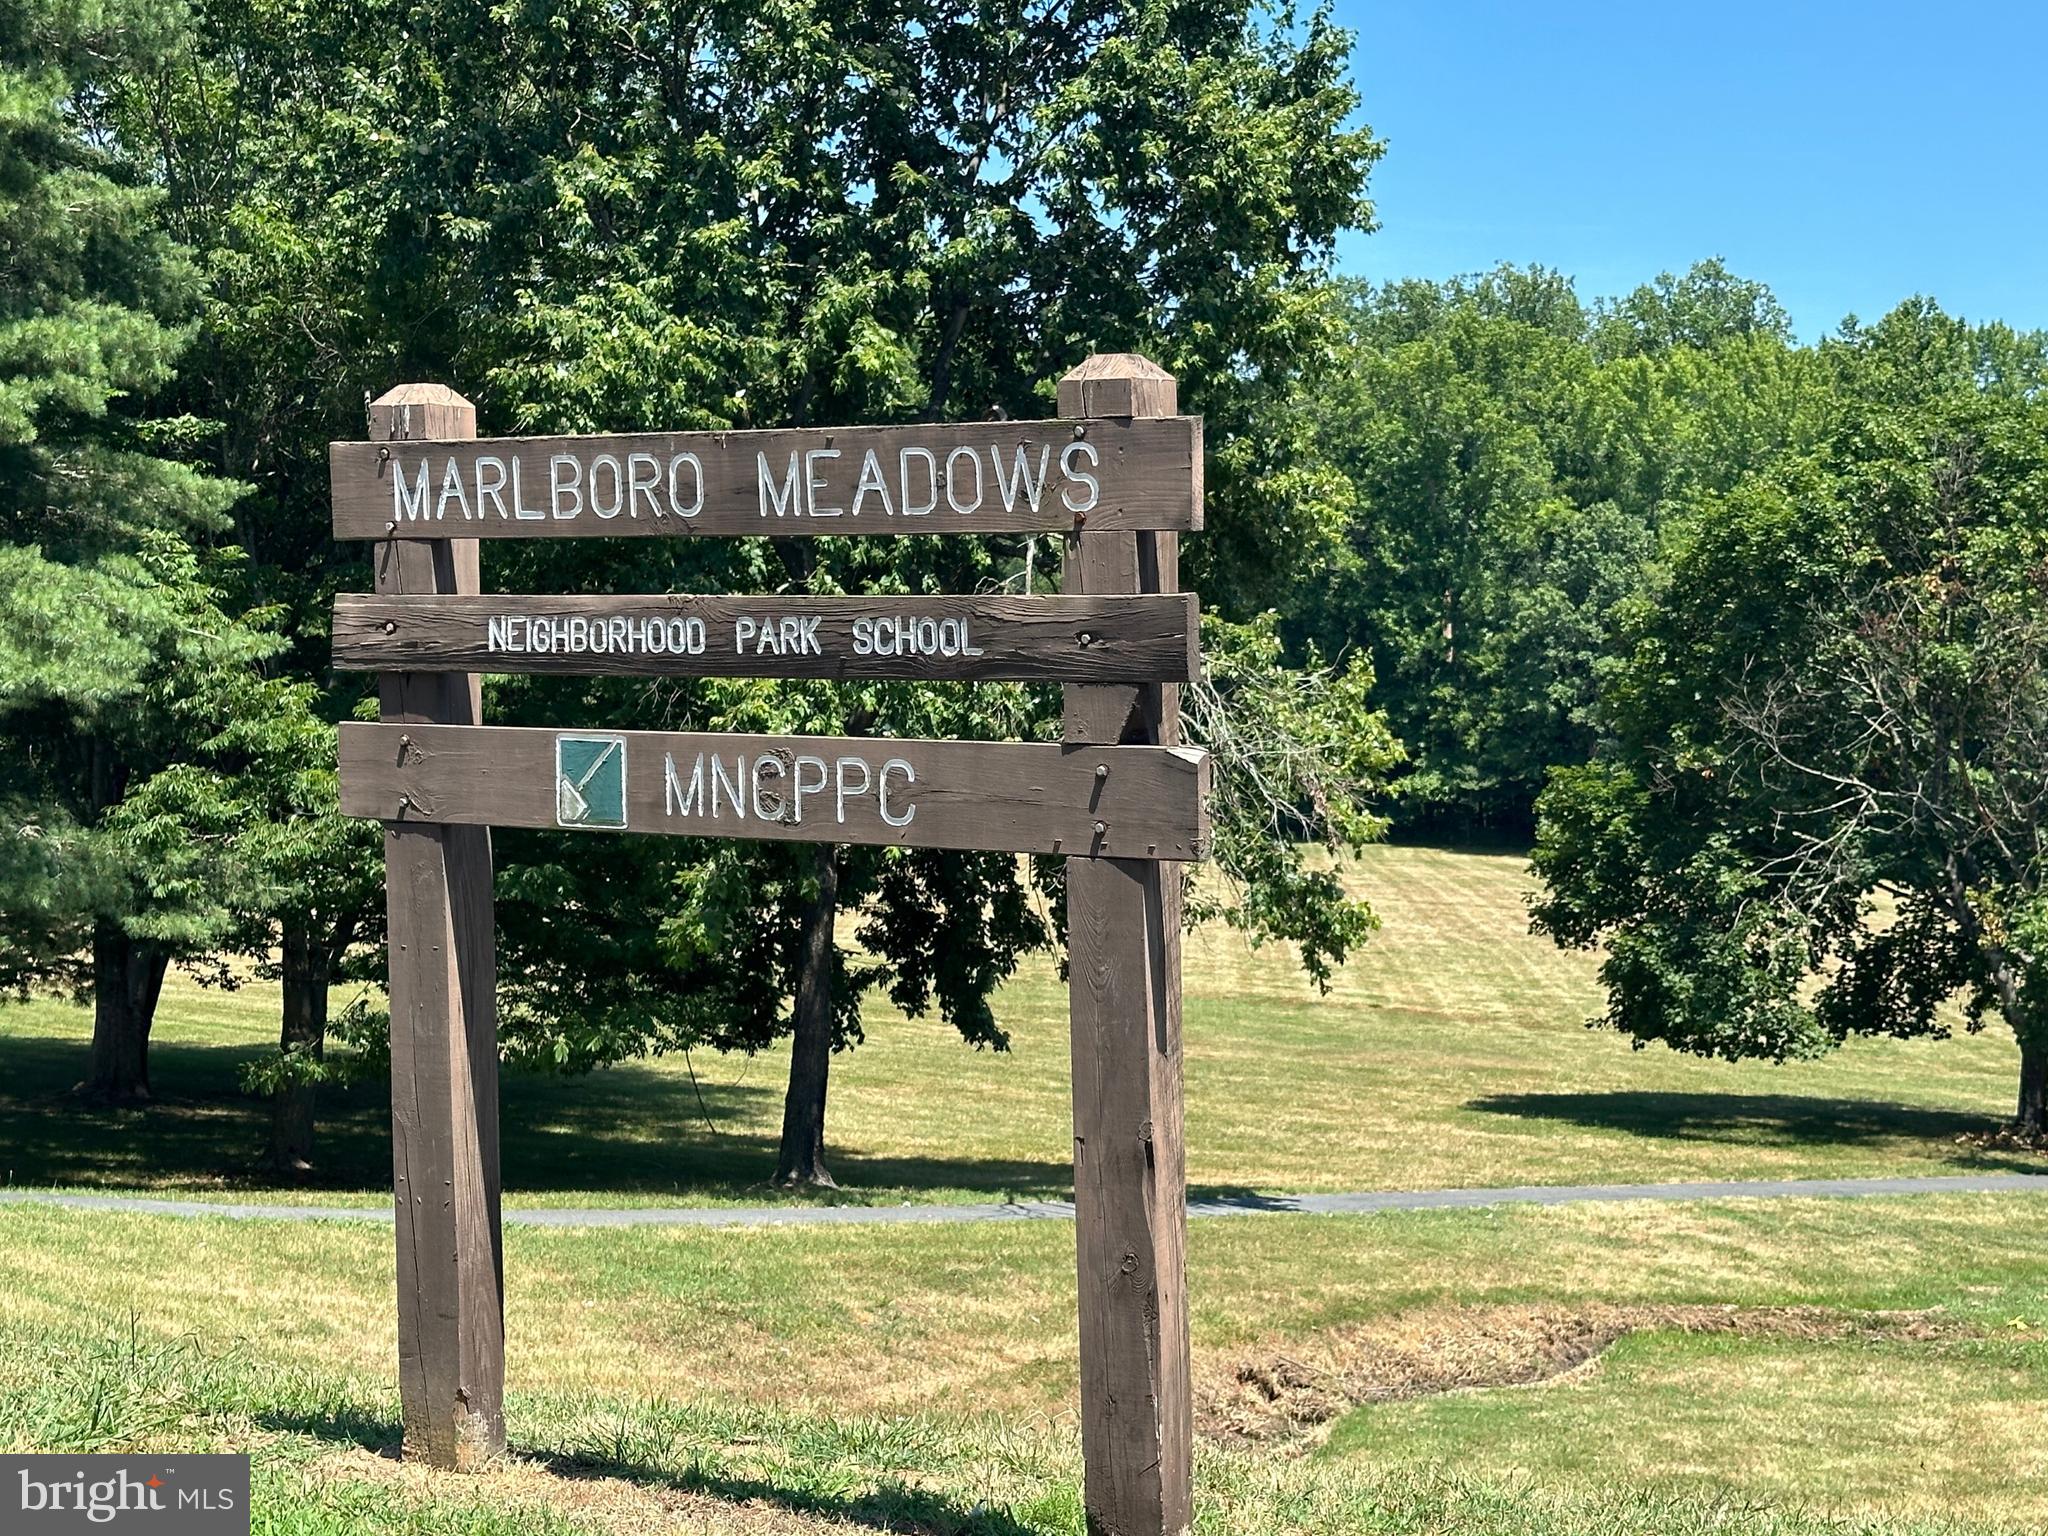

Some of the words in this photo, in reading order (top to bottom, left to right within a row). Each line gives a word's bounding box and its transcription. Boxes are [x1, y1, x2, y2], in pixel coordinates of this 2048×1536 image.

[393, 452, 705, 521] MARLBORO
[757, 441, 1100, 518] MEADOWS
[487, 615, 707, 656] NEIGHBORHOOD
[735, 615, 823, 656] PARK
[852, 616, 985, 658] SCHOOL
[664, 751, 916, 827] MNCPPC
